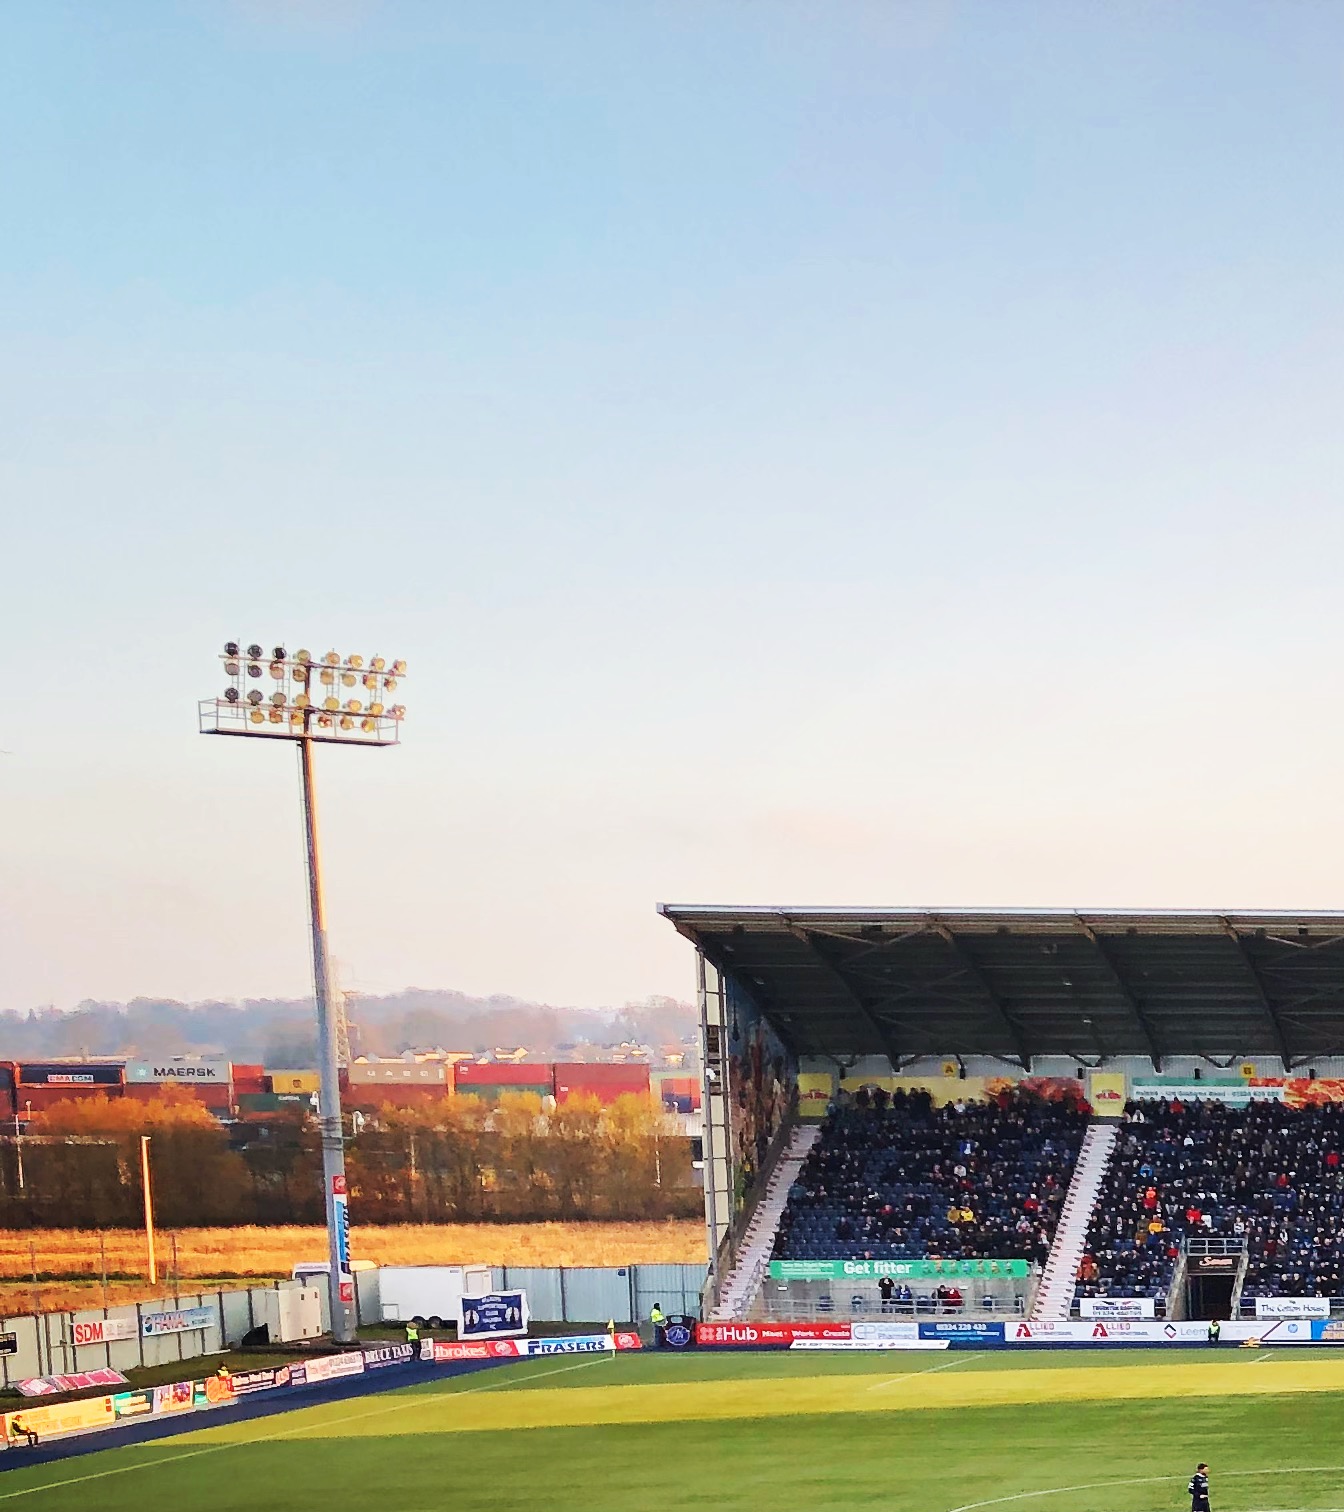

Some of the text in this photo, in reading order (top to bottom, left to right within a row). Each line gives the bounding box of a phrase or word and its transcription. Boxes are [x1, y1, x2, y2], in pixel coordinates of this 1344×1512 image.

[153, 1067, 215, 1078] MAERSK
[843, 1261, 871, 1275] Get
[873, 1261, 913, 1275] fitter
[75, 1322, 104, 1344] SDM
[723, 1326, 758, 1341] Hub
[434, 1344, 488, 1358] brokes
[527, 1341, 606, 1355] FRASERS
